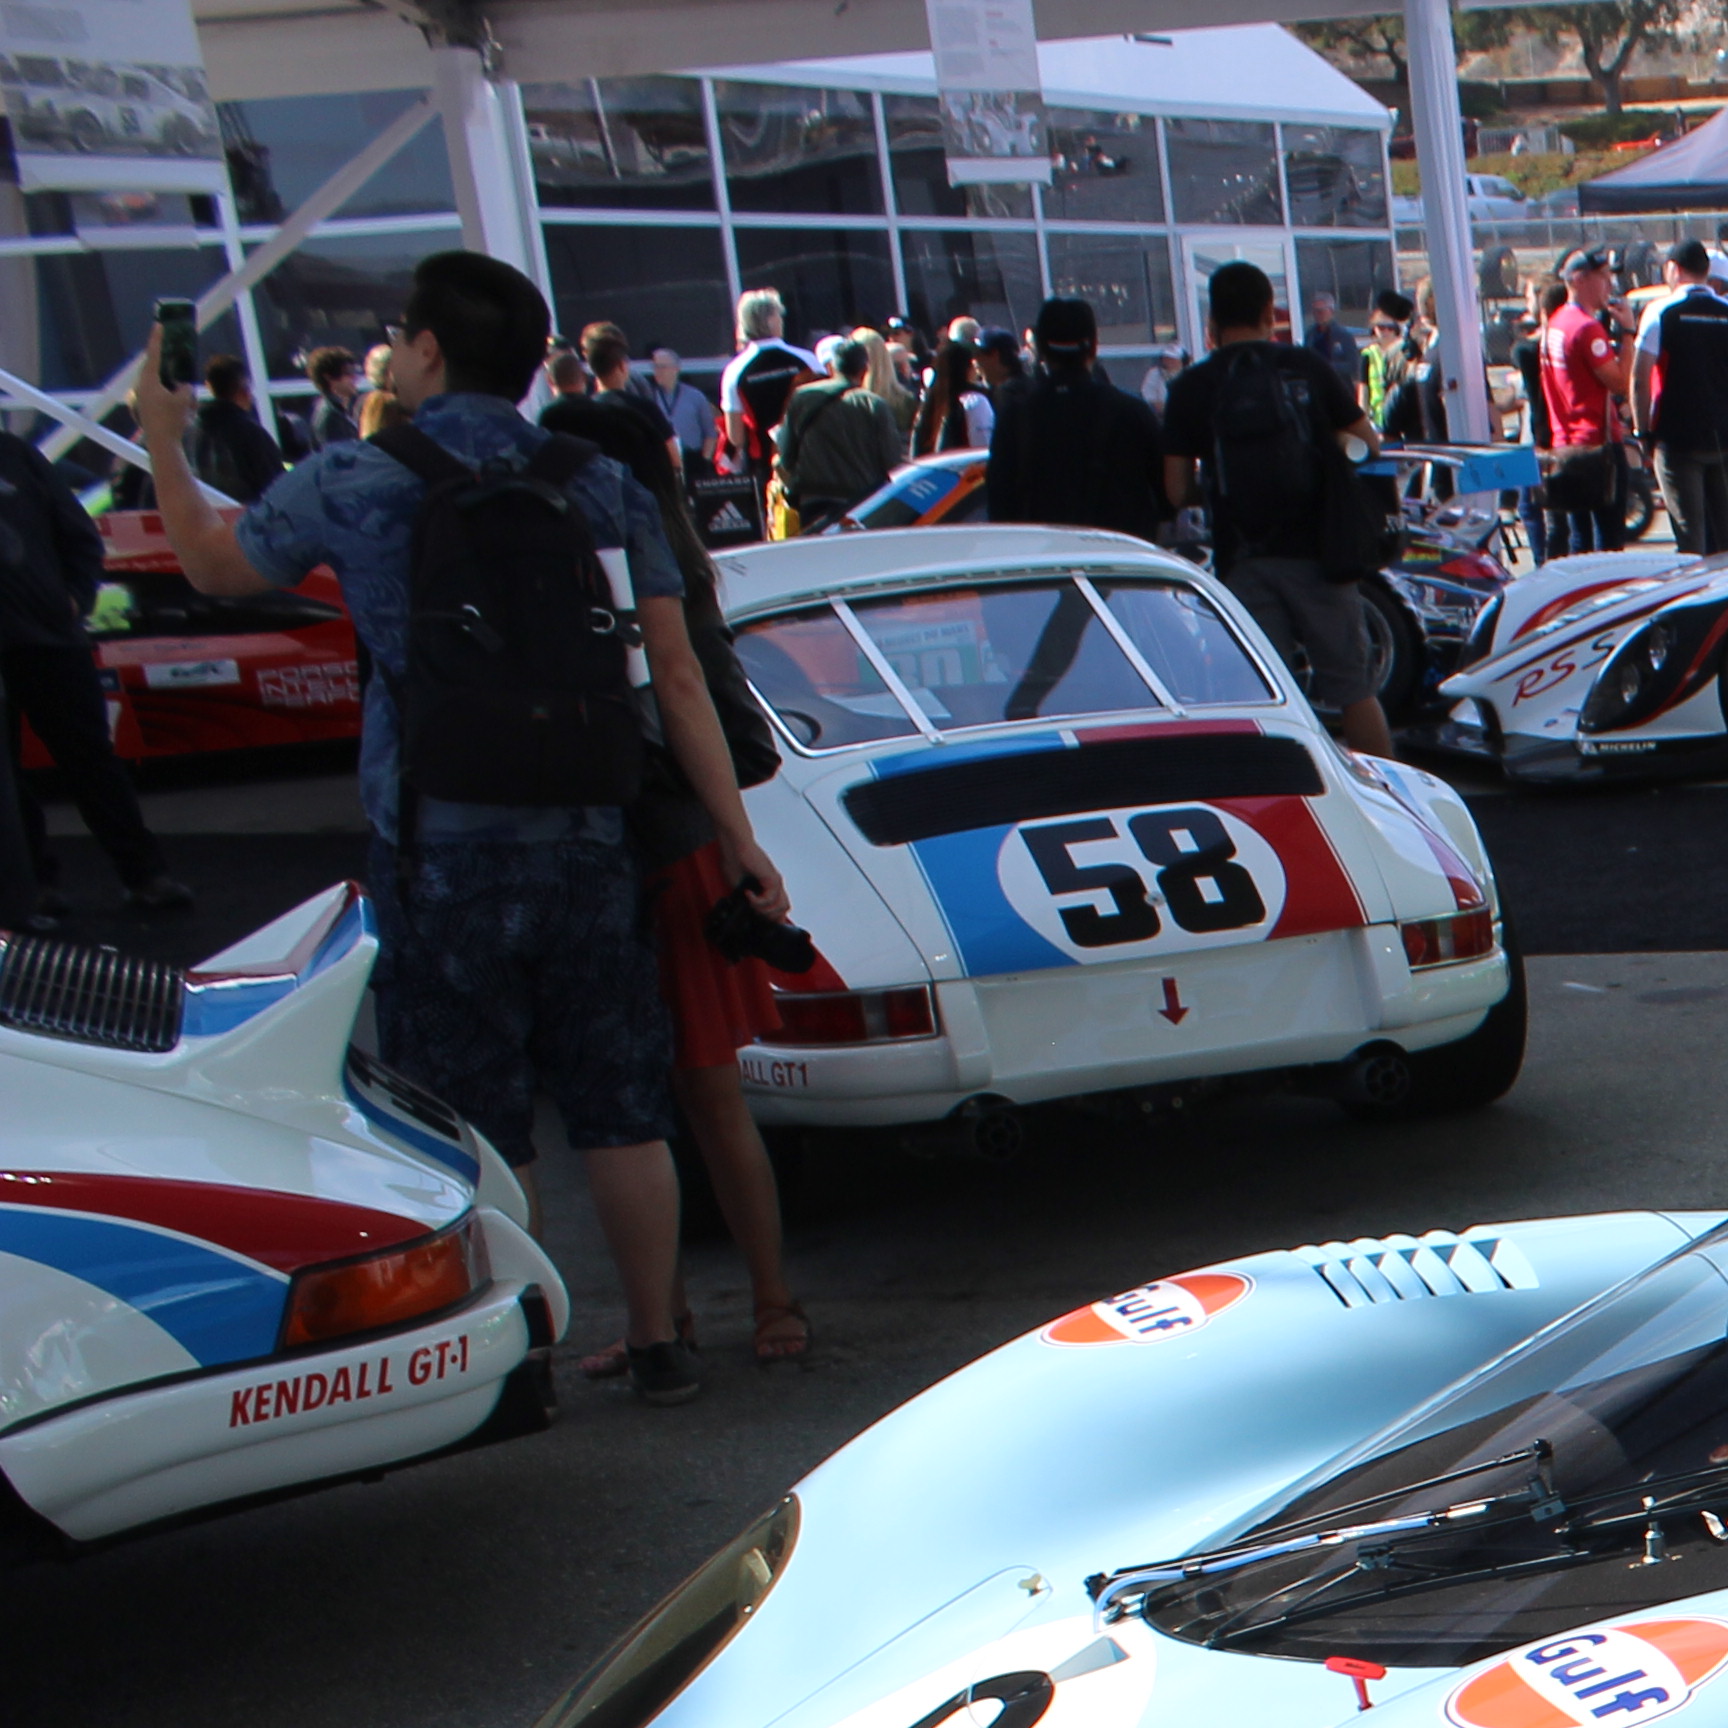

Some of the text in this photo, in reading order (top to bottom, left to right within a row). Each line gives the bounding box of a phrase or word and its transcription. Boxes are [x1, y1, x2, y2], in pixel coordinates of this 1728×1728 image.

[1018, 806, 1267, 948] 58
[1101, 1284, 1193, 1336] Gulf
[229, 1357, 394, 1428] KENDALL
[1523, 1632, 1672, 1720] Gulf
